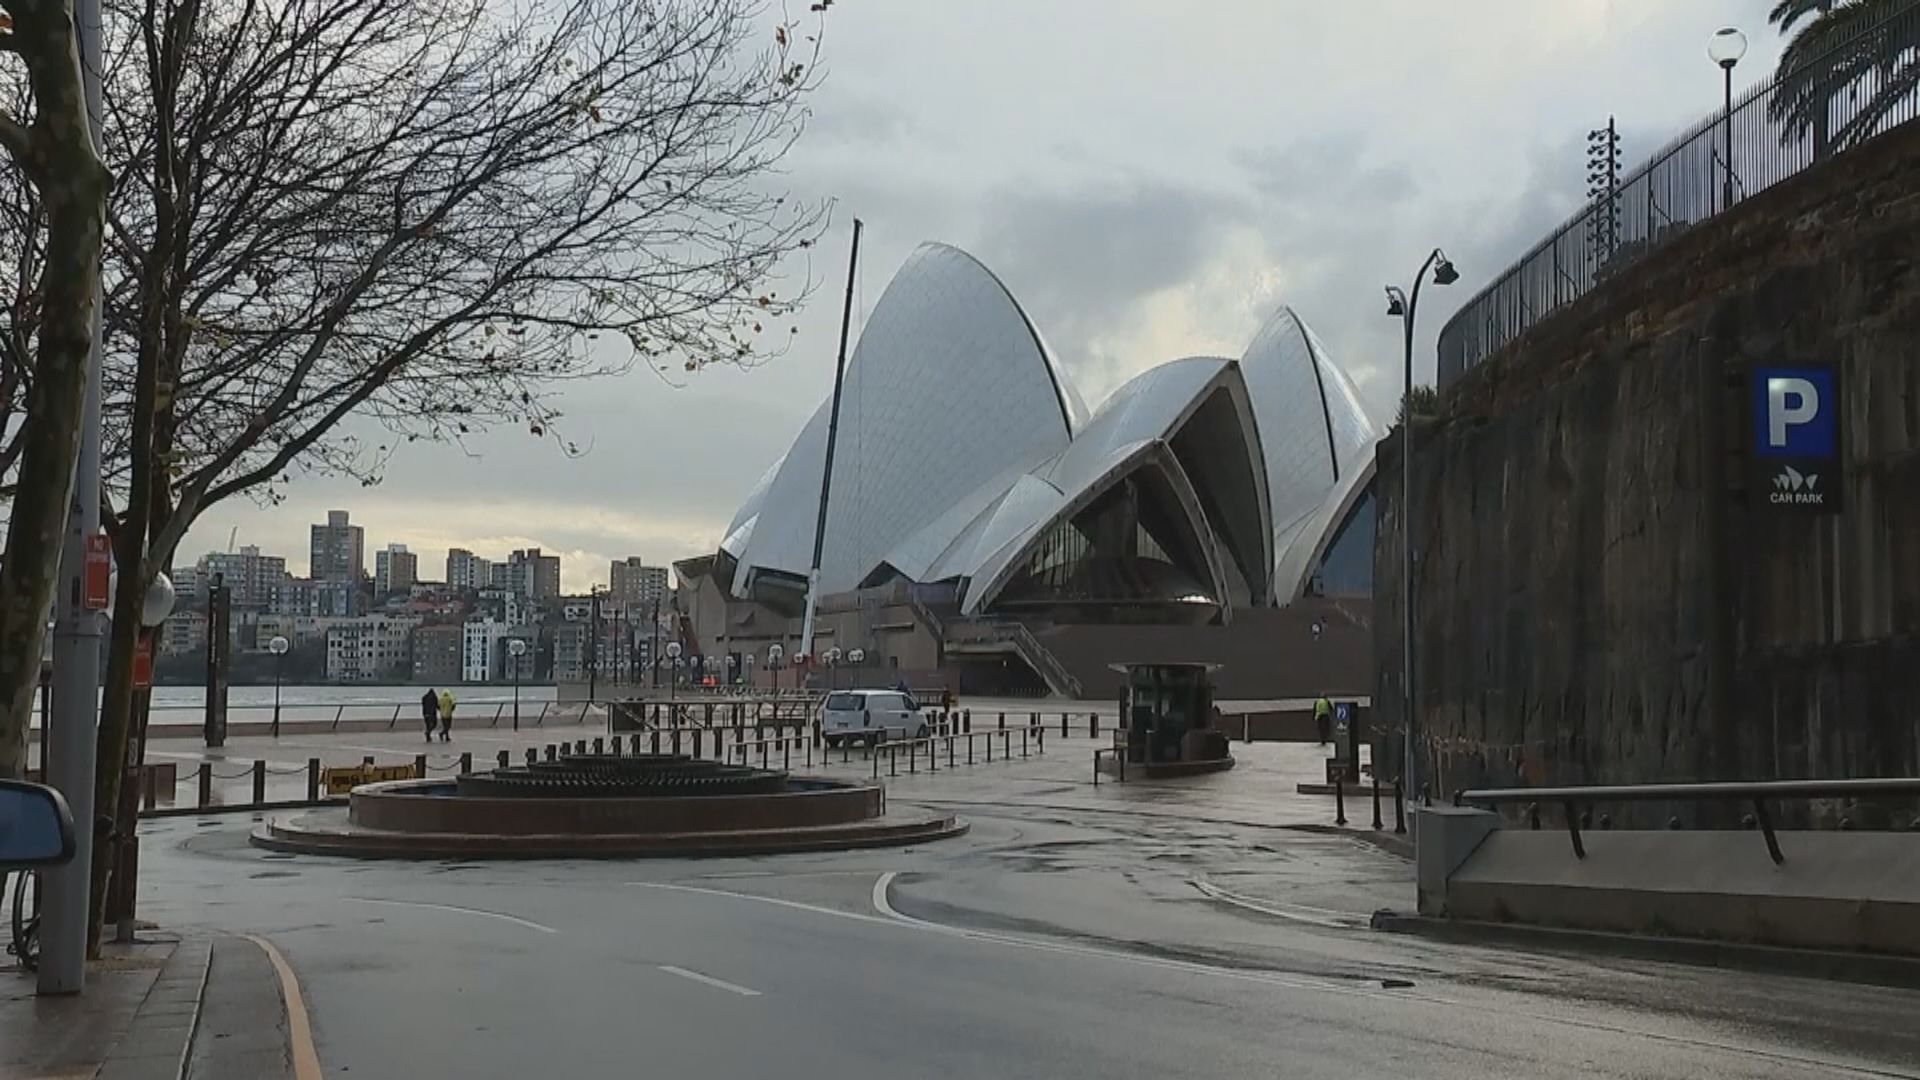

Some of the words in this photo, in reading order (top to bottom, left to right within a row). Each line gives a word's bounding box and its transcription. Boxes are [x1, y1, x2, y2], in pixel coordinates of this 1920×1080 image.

[1768, 378, 1819, 446] P
[1770, 492, 1793, 503] CAR
[1795, 492, 1823, 503] PARK
